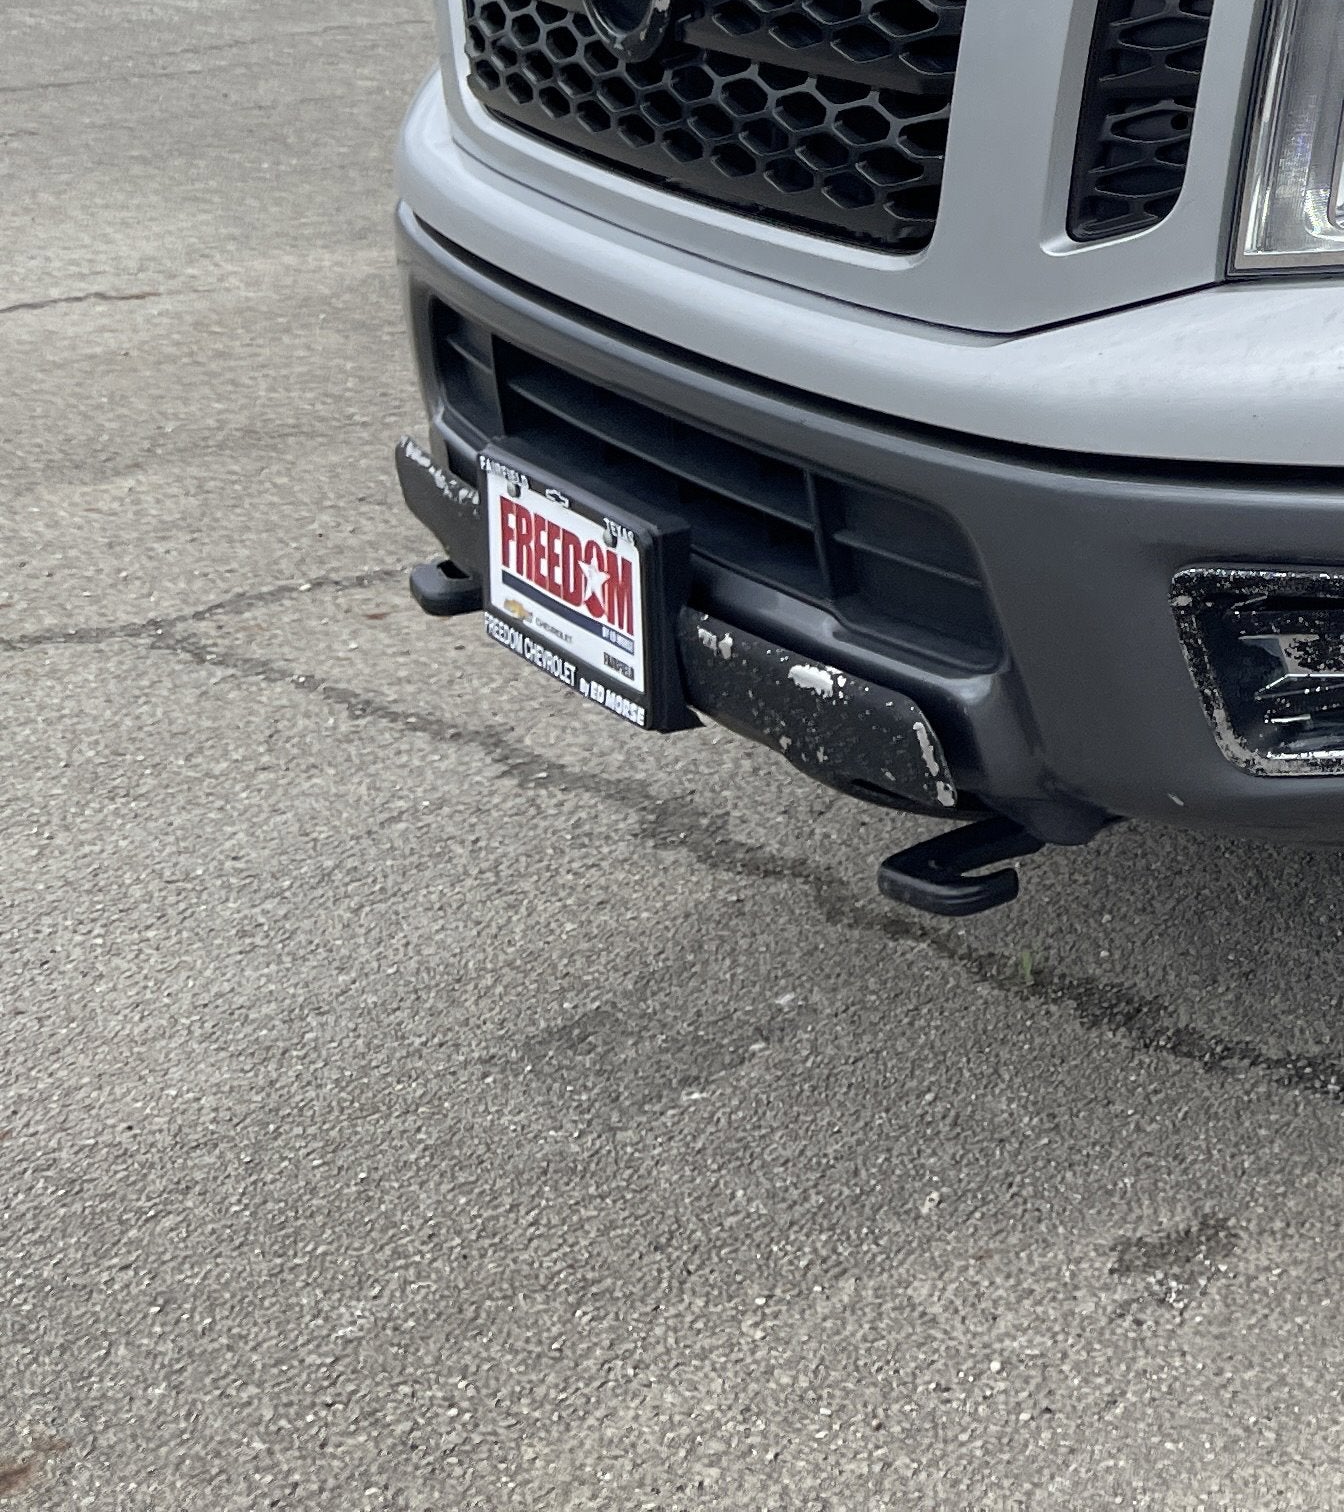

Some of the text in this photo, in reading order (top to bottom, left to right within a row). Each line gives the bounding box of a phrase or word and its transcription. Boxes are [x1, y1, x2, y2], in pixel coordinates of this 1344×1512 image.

[500, 496, 634, 637] FREEDOM
[602, 517, 635, 546] TEXAS
[484, 611, 523, 655] FREEDOM
[524, 637, 577, 687] CHEVROLET
[590, 680, 605, 705] ED
[605, 688, 645, 727] MORSE
